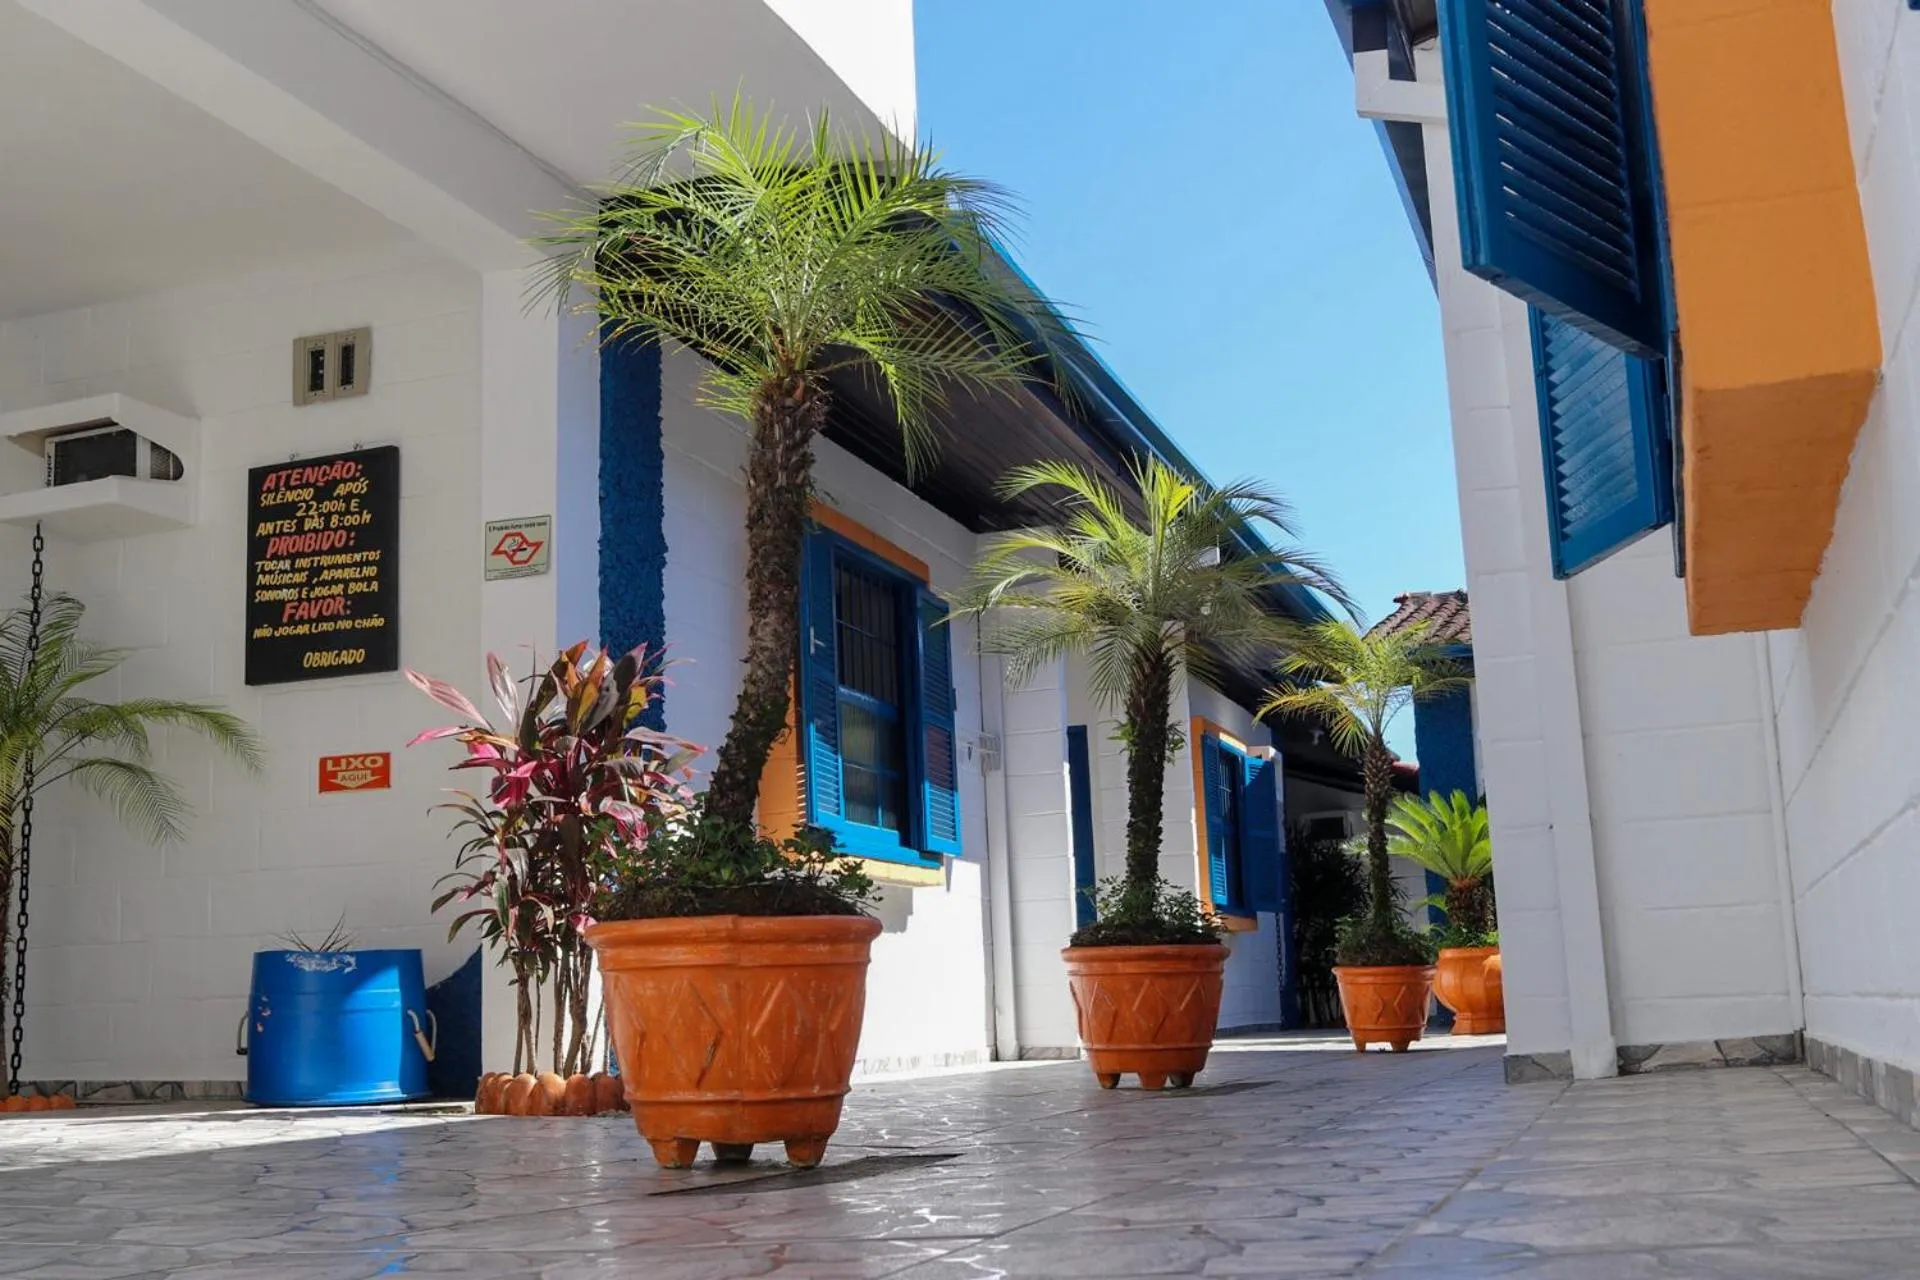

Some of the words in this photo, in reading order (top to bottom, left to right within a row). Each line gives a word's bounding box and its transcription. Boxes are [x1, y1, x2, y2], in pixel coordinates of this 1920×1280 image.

[262, 461, 362, 491] ATENÇÃO:
[260, 487, 314, 507] SILÊNCIO
[333, 477, 369, 497] APÓS
[296, 499, 346, 517] 22:00h
[350, 499, 361, 511] E
[256, 519, 297, 537] ANTES
[330, 509, 372, 529] 8:00h
[255, 560, 291, 572] TOCAR
[295, 550, 381, 568] INSTRUMENTOS
[320, 566, 378, 581] APARELHO
[255, 588, 299, 602] SONOROS
[301, 587, 309, 598] E
[310, 583, 344, 598] JOGAR
[348, 581, 379, 594] BOLA
[282, 597, 351, 623] FAVOR:
[253, 624, 273, 639] NÃO
[274, 624, 310, 637] JOGAR
[311, 621, 335, 633] LIXO
[336, 618, 352, 630] NO
[354, 614, 385, 629] CHÃO
[303, 648, 366, 668] OBRIGADO
[327, 756, 384, 771] LIXO
